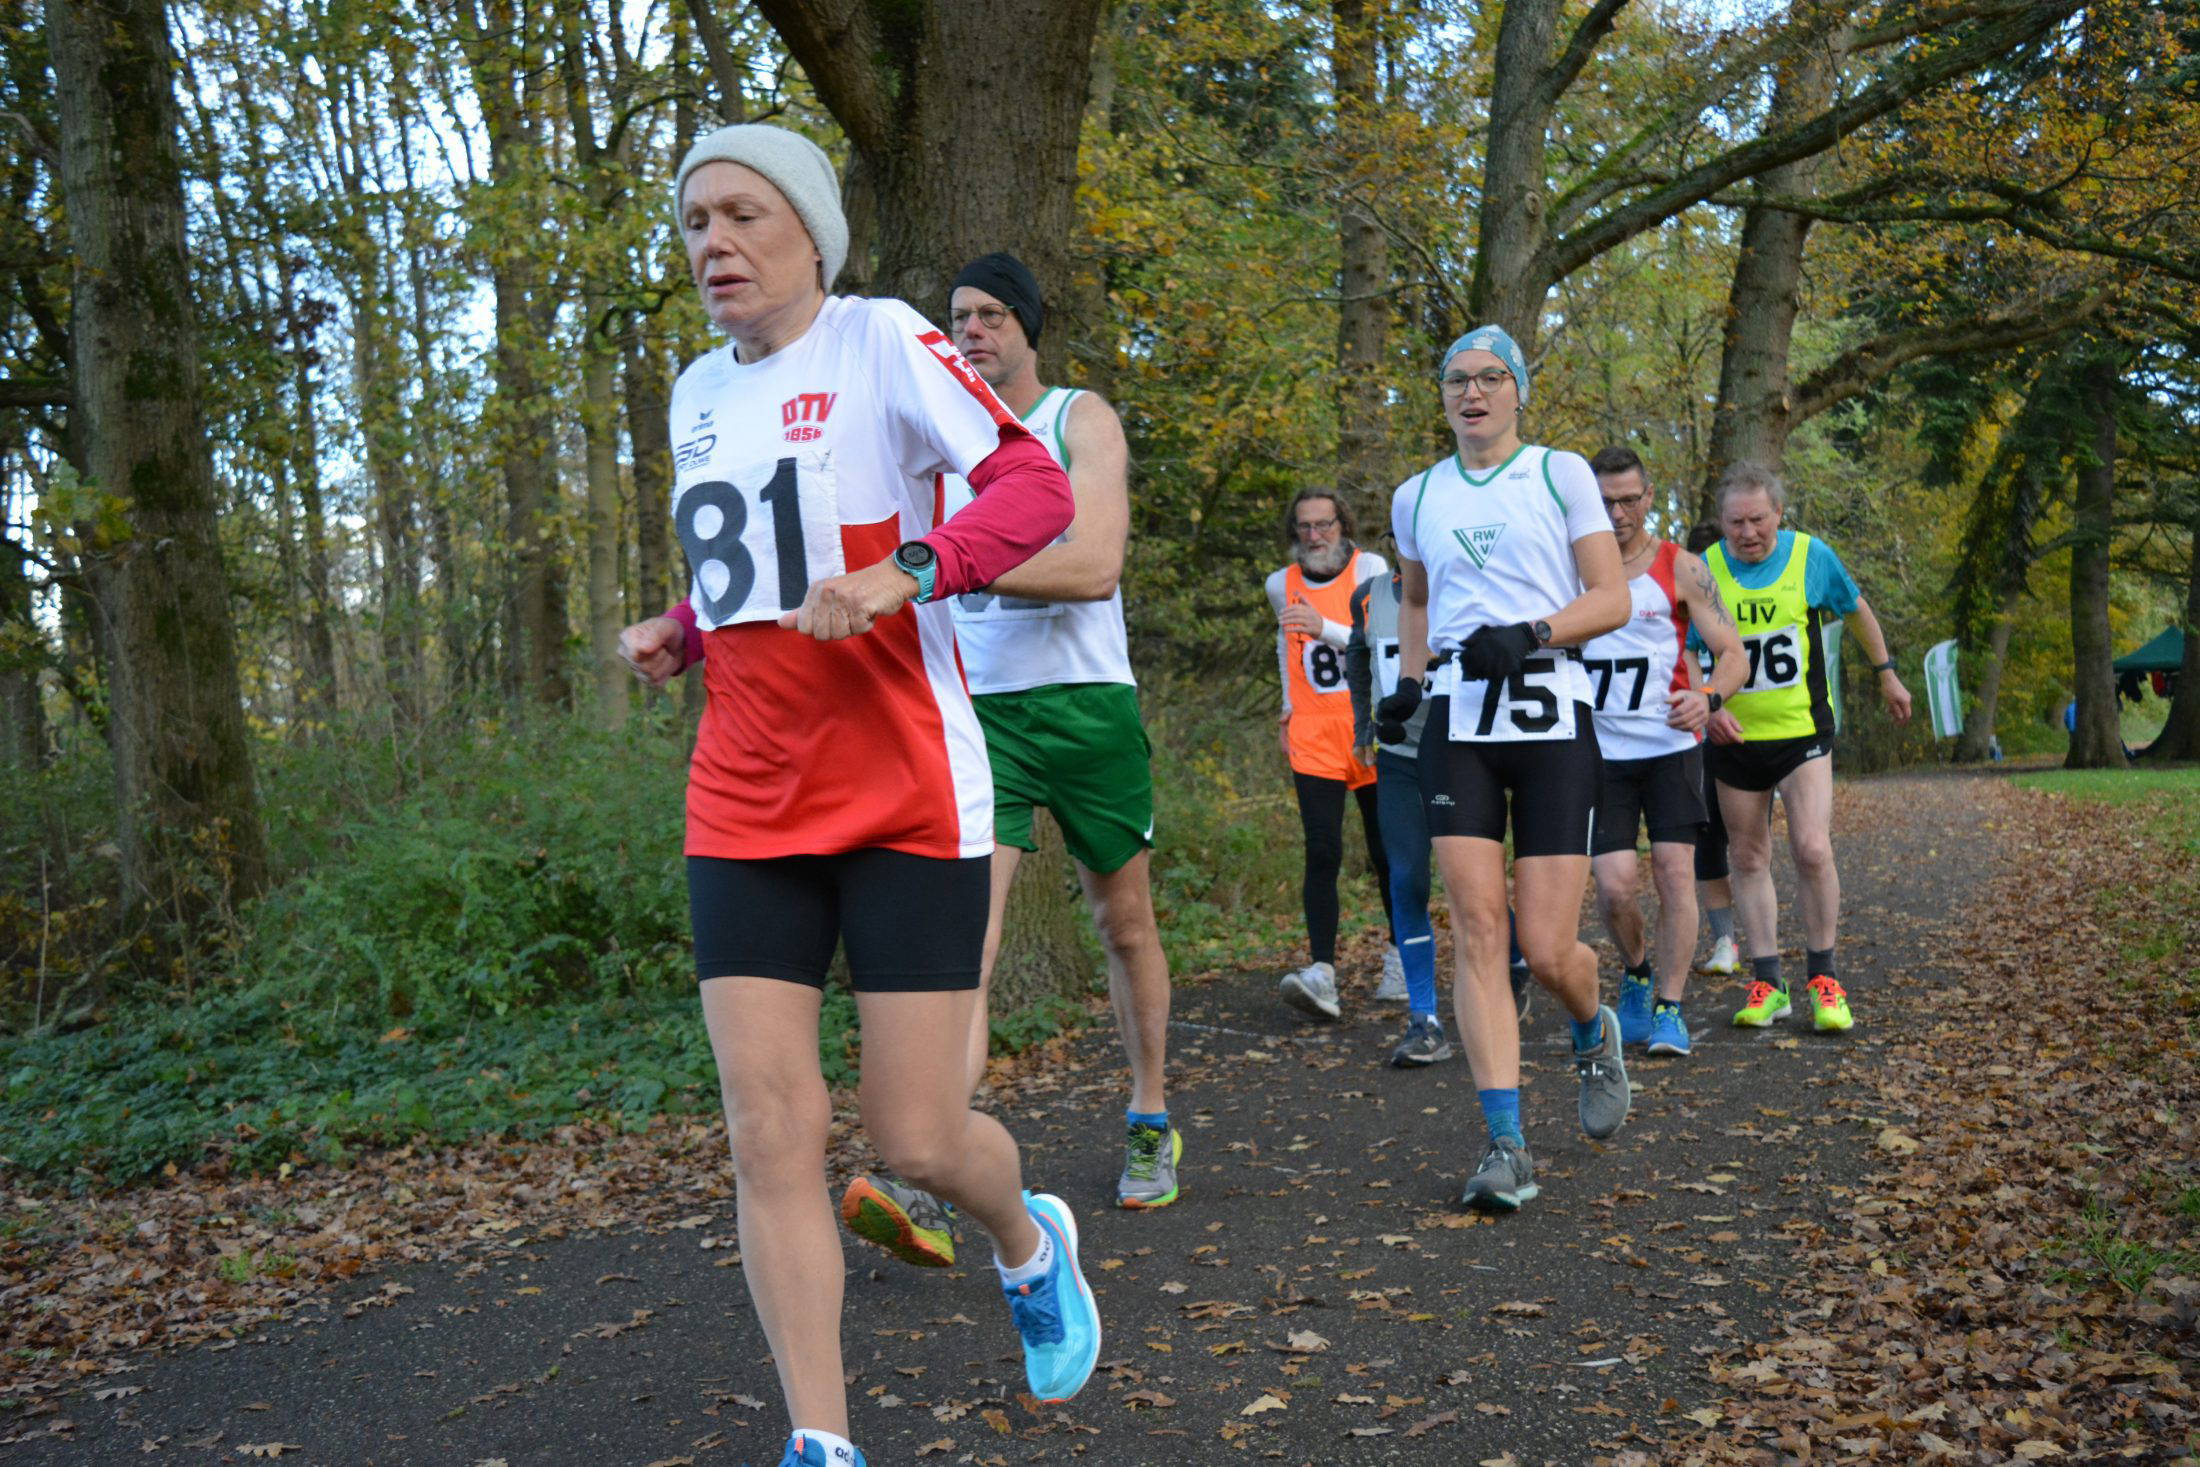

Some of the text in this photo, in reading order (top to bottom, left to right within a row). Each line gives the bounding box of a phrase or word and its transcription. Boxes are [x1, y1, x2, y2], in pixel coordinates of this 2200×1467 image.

[675, 456, 809, 626] 81
[1473, 528, 1497, 542] RW
[1480, 543, 1490, 556] V
[1736, 602, 1777, 625] LIV
[1311, 644, 1348, 688] 8
[1581, 656, 1649, 712] 77
[1742, 633, 1798, 689] 76
[1460, 657, 1560, 736] 75
